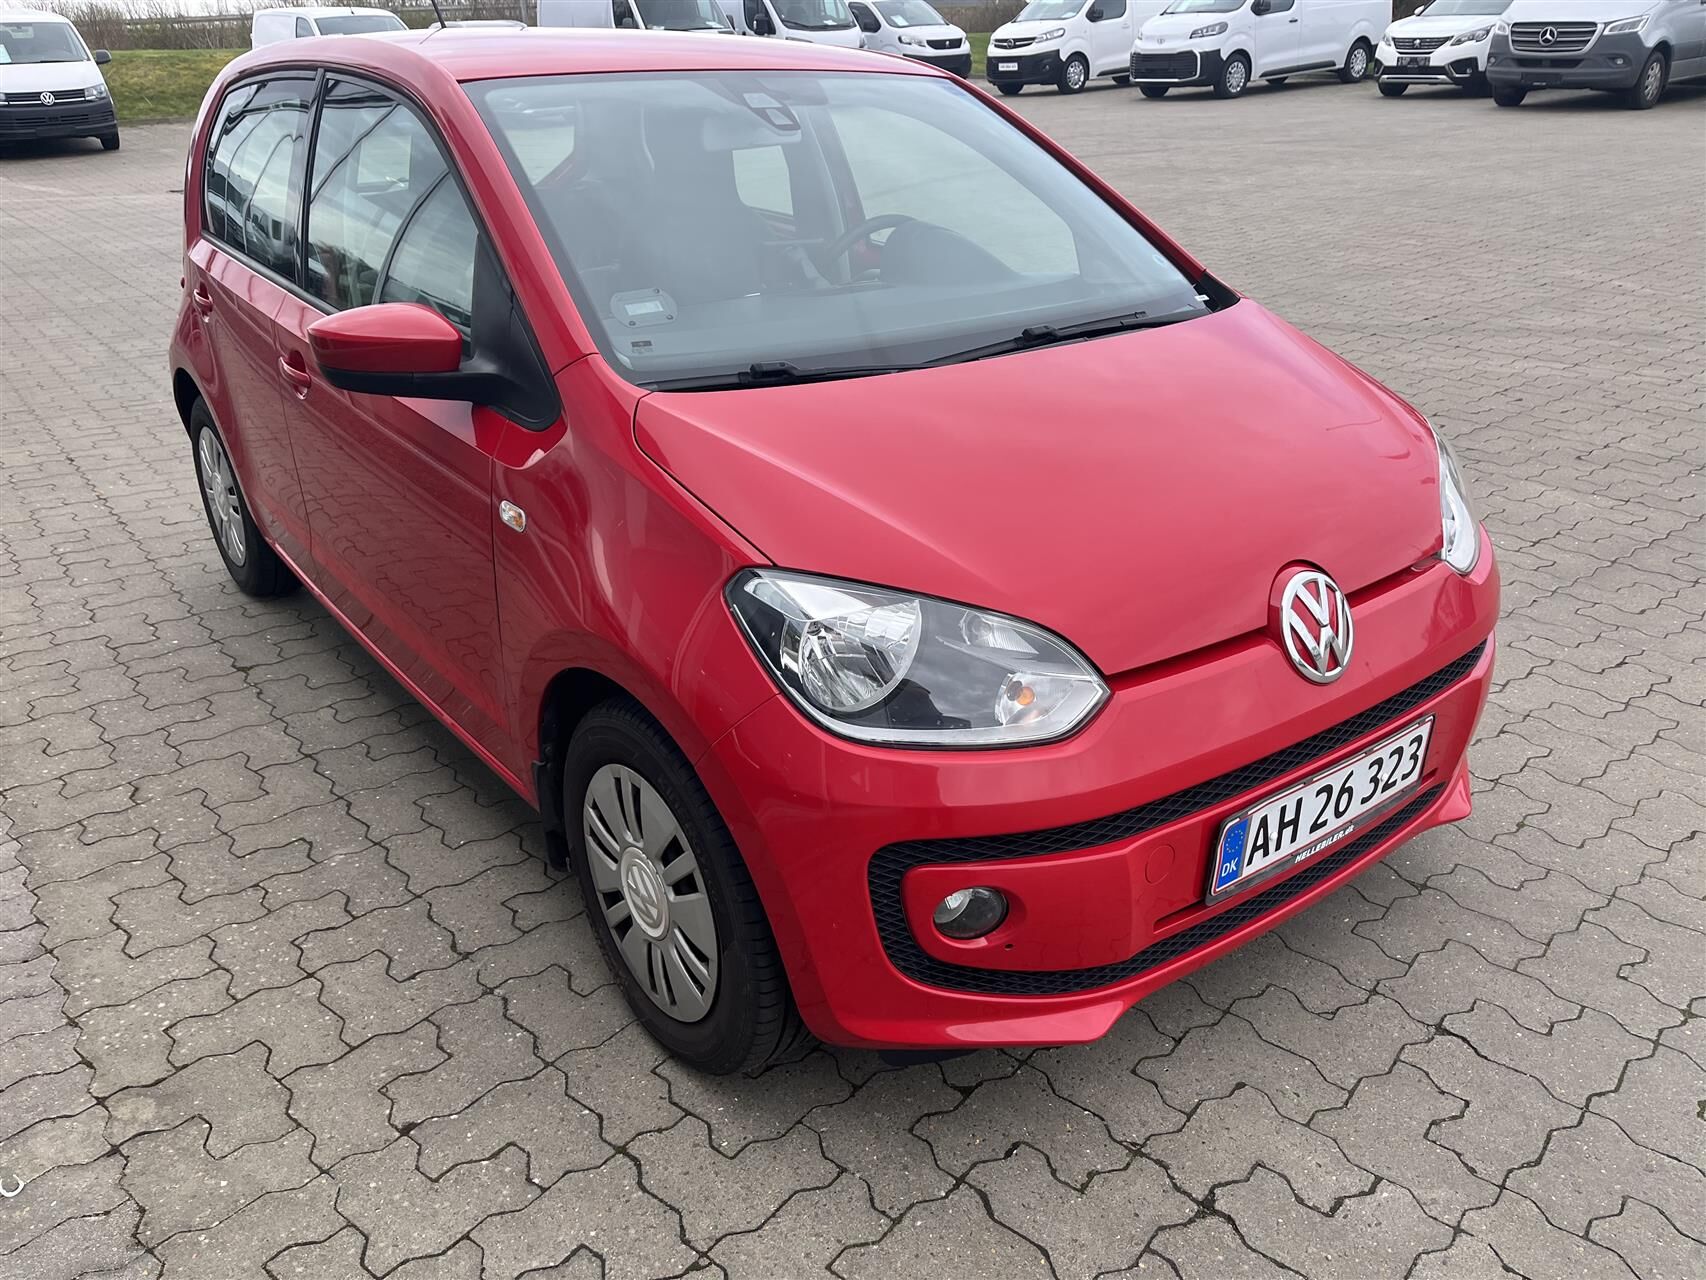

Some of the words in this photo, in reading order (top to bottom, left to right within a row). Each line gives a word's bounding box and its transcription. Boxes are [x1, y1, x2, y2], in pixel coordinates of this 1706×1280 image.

[1281, 570, 1353, 683] VW
[1246, 797, 1303, 867] AH
[1309, 770, 1354, 834] 26
[1360, 734, 1423, 805] 323
[1221, 857, 1239, 877] DK
